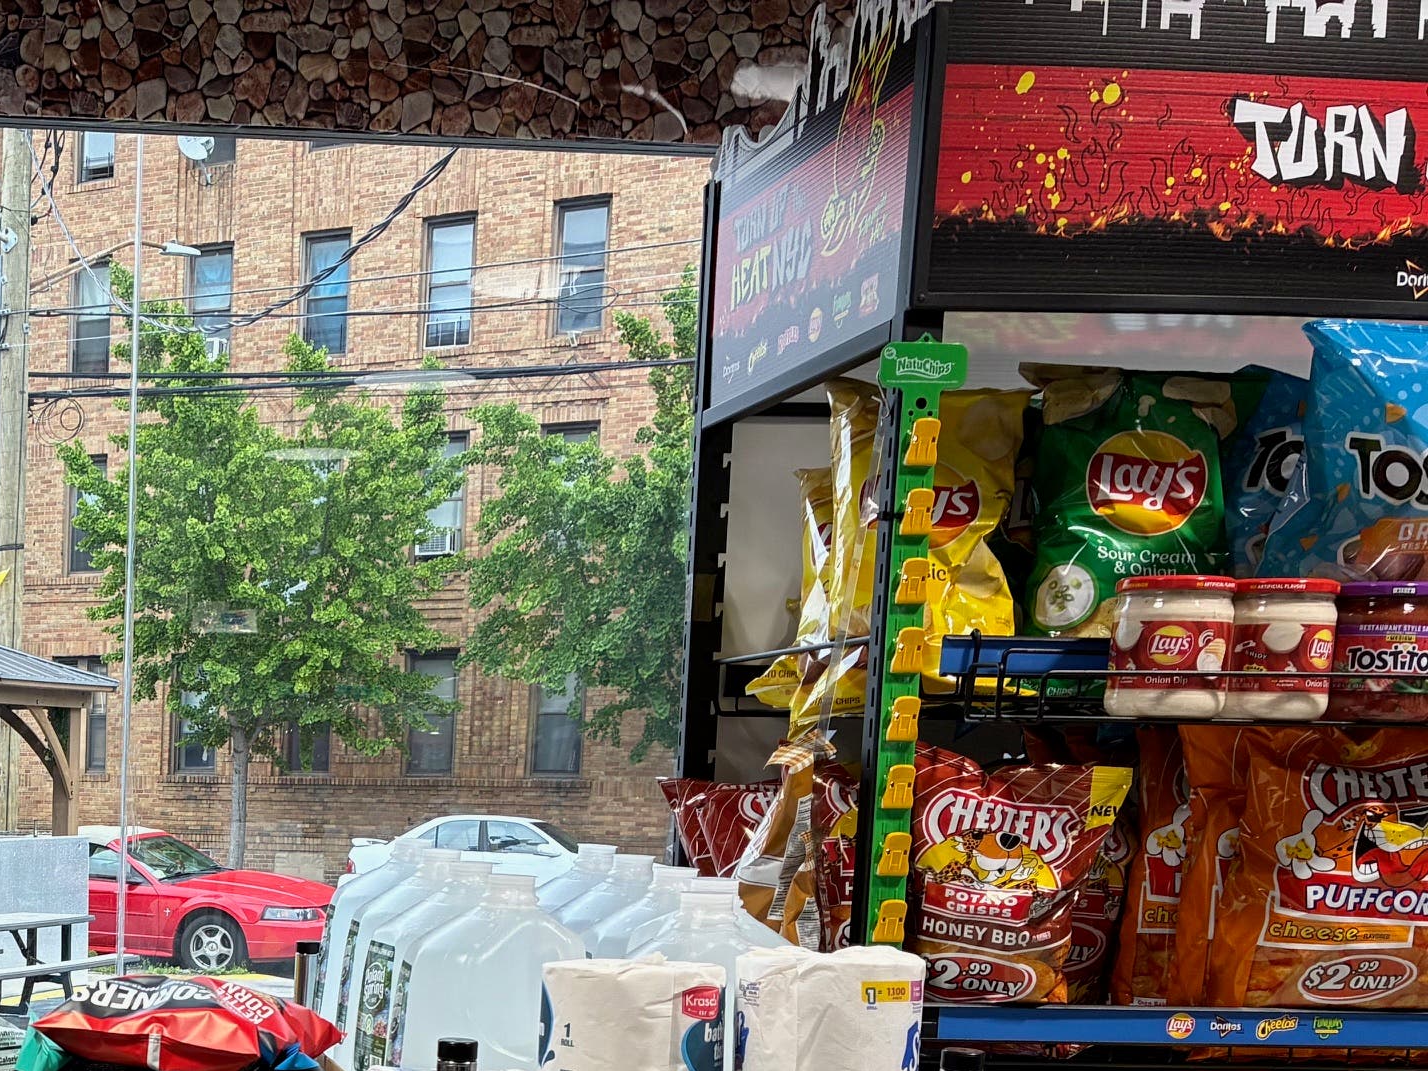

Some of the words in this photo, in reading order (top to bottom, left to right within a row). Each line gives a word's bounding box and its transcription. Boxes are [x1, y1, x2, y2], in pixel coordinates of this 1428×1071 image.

[1234, 99, 1407, 184] TURN
[731, 245, 771, 310] HEAT
[897, 357, 950, 377] NatuChips
[1093, 454, 1201, 511] Lay's
[1097, 545, 1135, 562] Sour
[1139, 549, 1196, 565] Cream
[1150, 633, 1191, 657] Lay's
[1145, 676, 1171, 685] Onion
[1174, 676, 1188, 686] Dip
[933, 793, 1073, 862] CHESTER'S
[943, 889, 1018, 907] POTATO
[946, 902, 1012, 918] CRISPS
[922, 917, 987, 941] HONEY
[991, 927, 1030, 949] BBQ
[1269, 921, 1359, 941] cheese
[962, 978, 1021, 996] ONLY
[1256, 1017, 1299, 1040] Cheetos
[560, 1038, 574, 1047] ROLL
